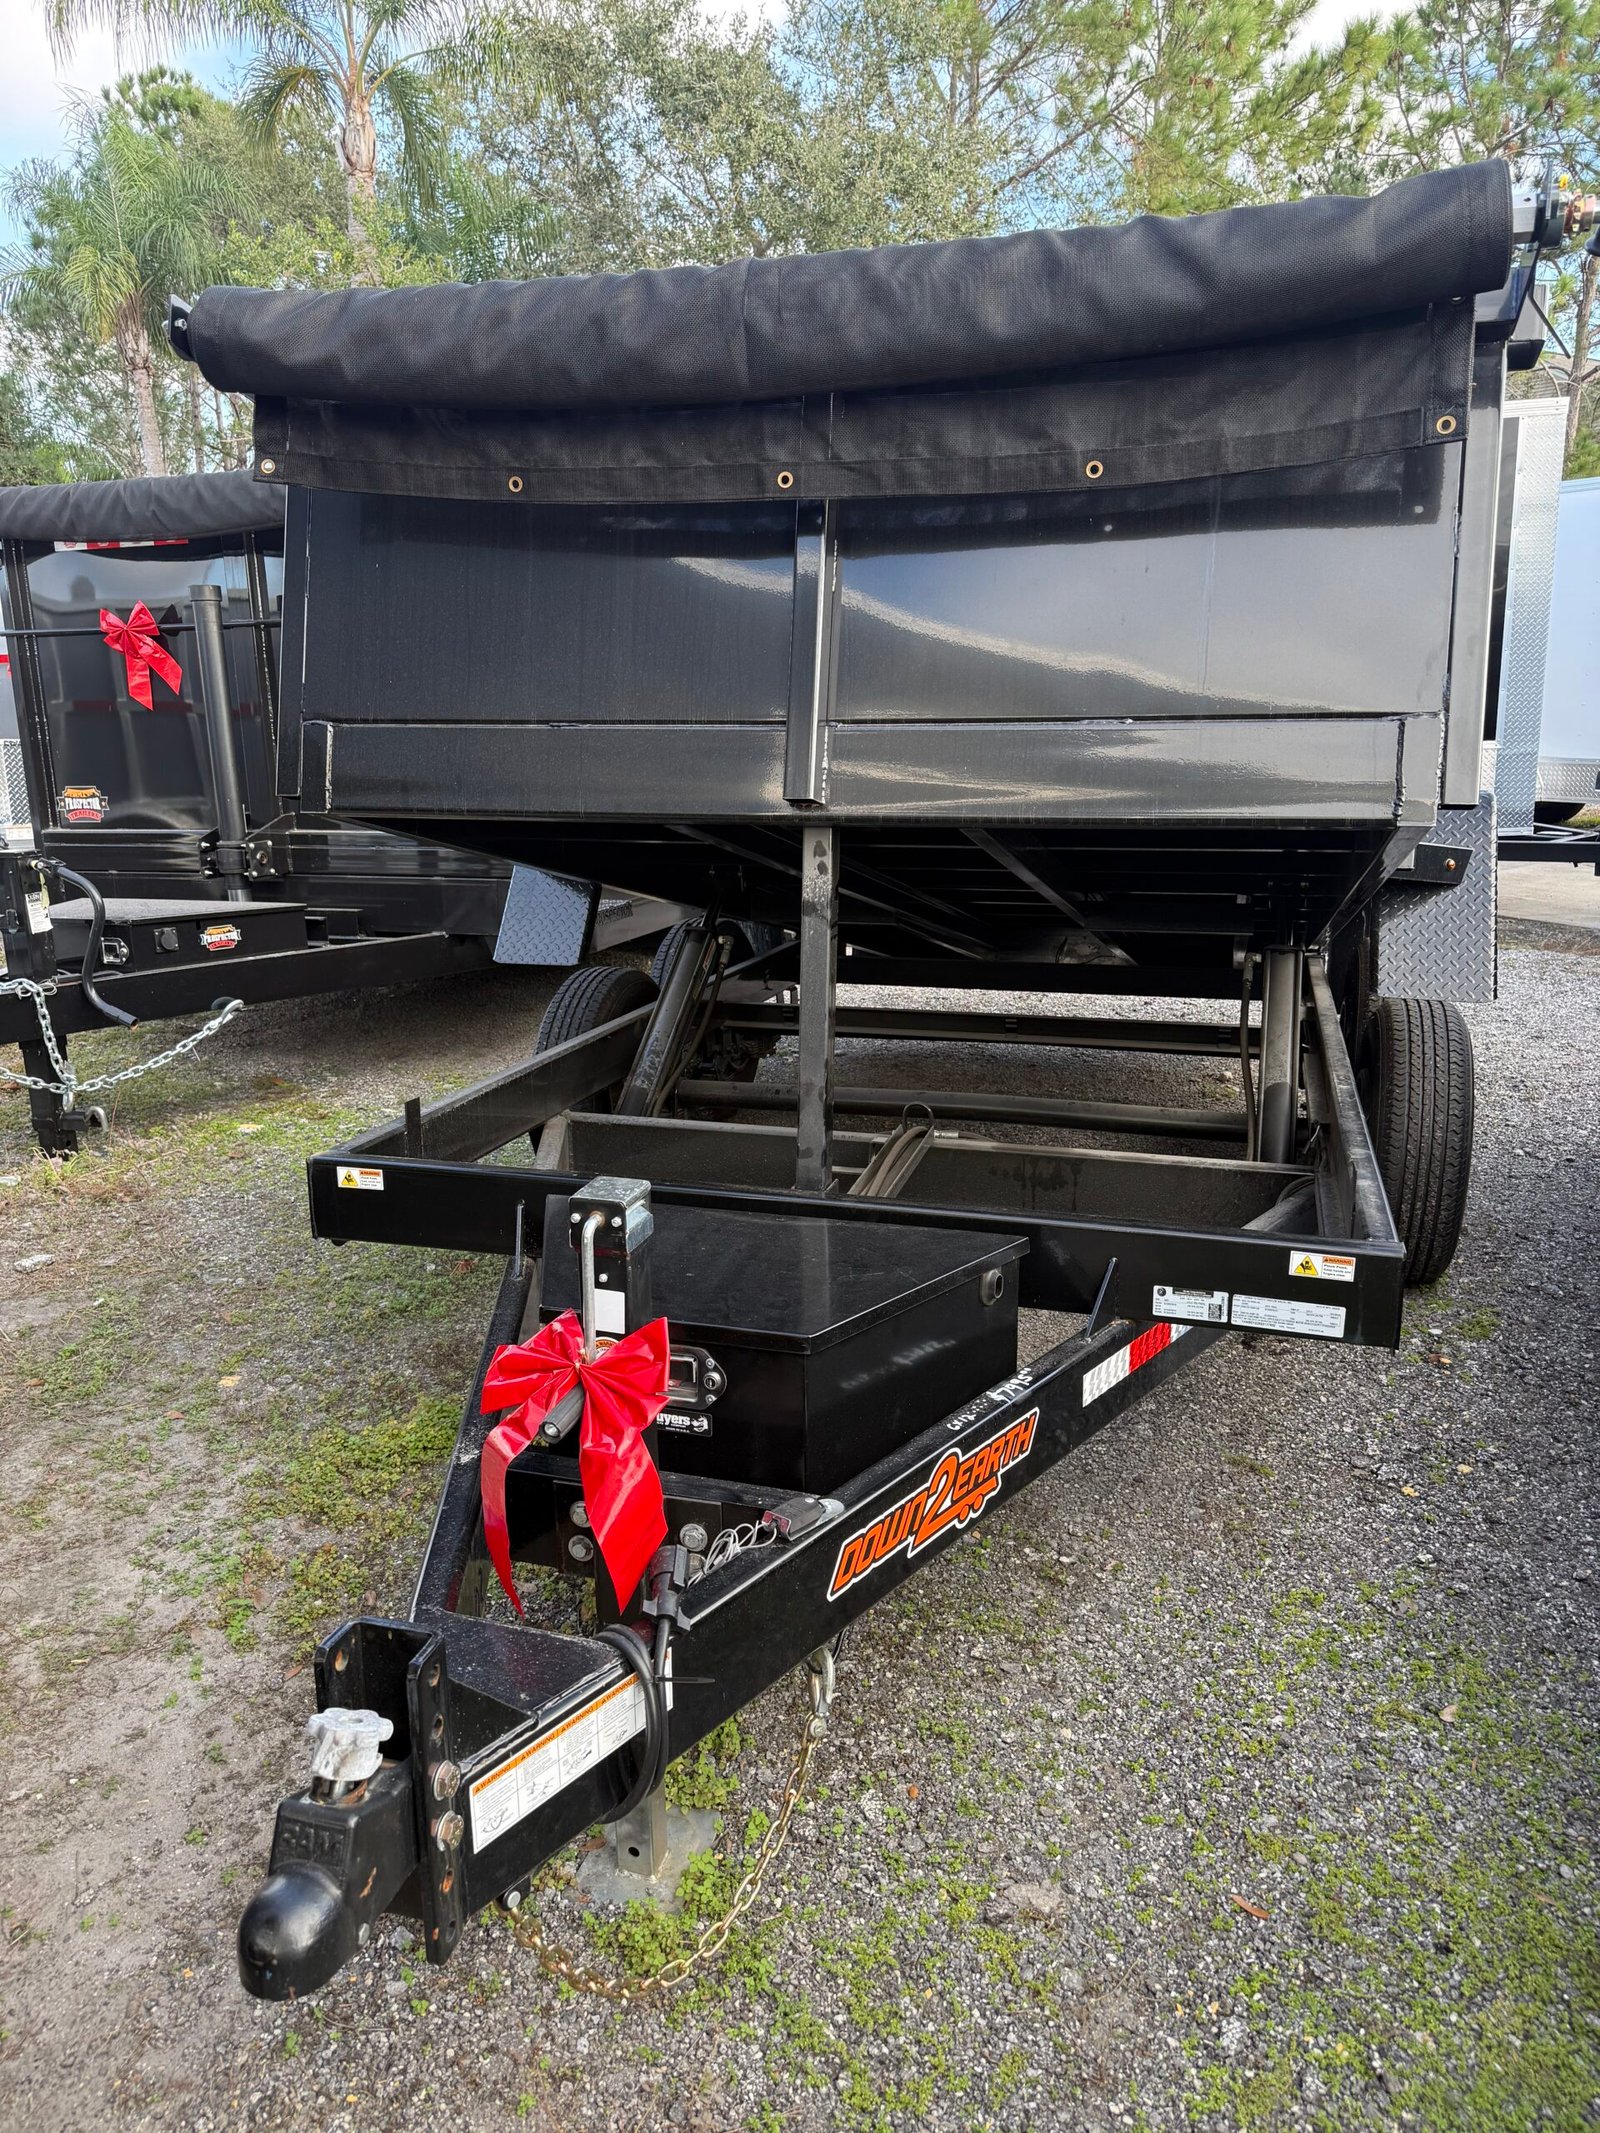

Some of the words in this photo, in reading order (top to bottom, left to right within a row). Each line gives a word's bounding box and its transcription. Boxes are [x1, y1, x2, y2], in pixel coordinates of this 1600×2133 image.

[656, 1412, 691, 1426] uyers
[831, 1413, 1036, 1593] DOWN2EARTH
[606, 1678, 634, 1702] WARNING
[566, 1705, 594, 1729] WARNING
[526, 1733, 556, 1758] WARNING
[479, 1763, 512, 1788] WARNING
